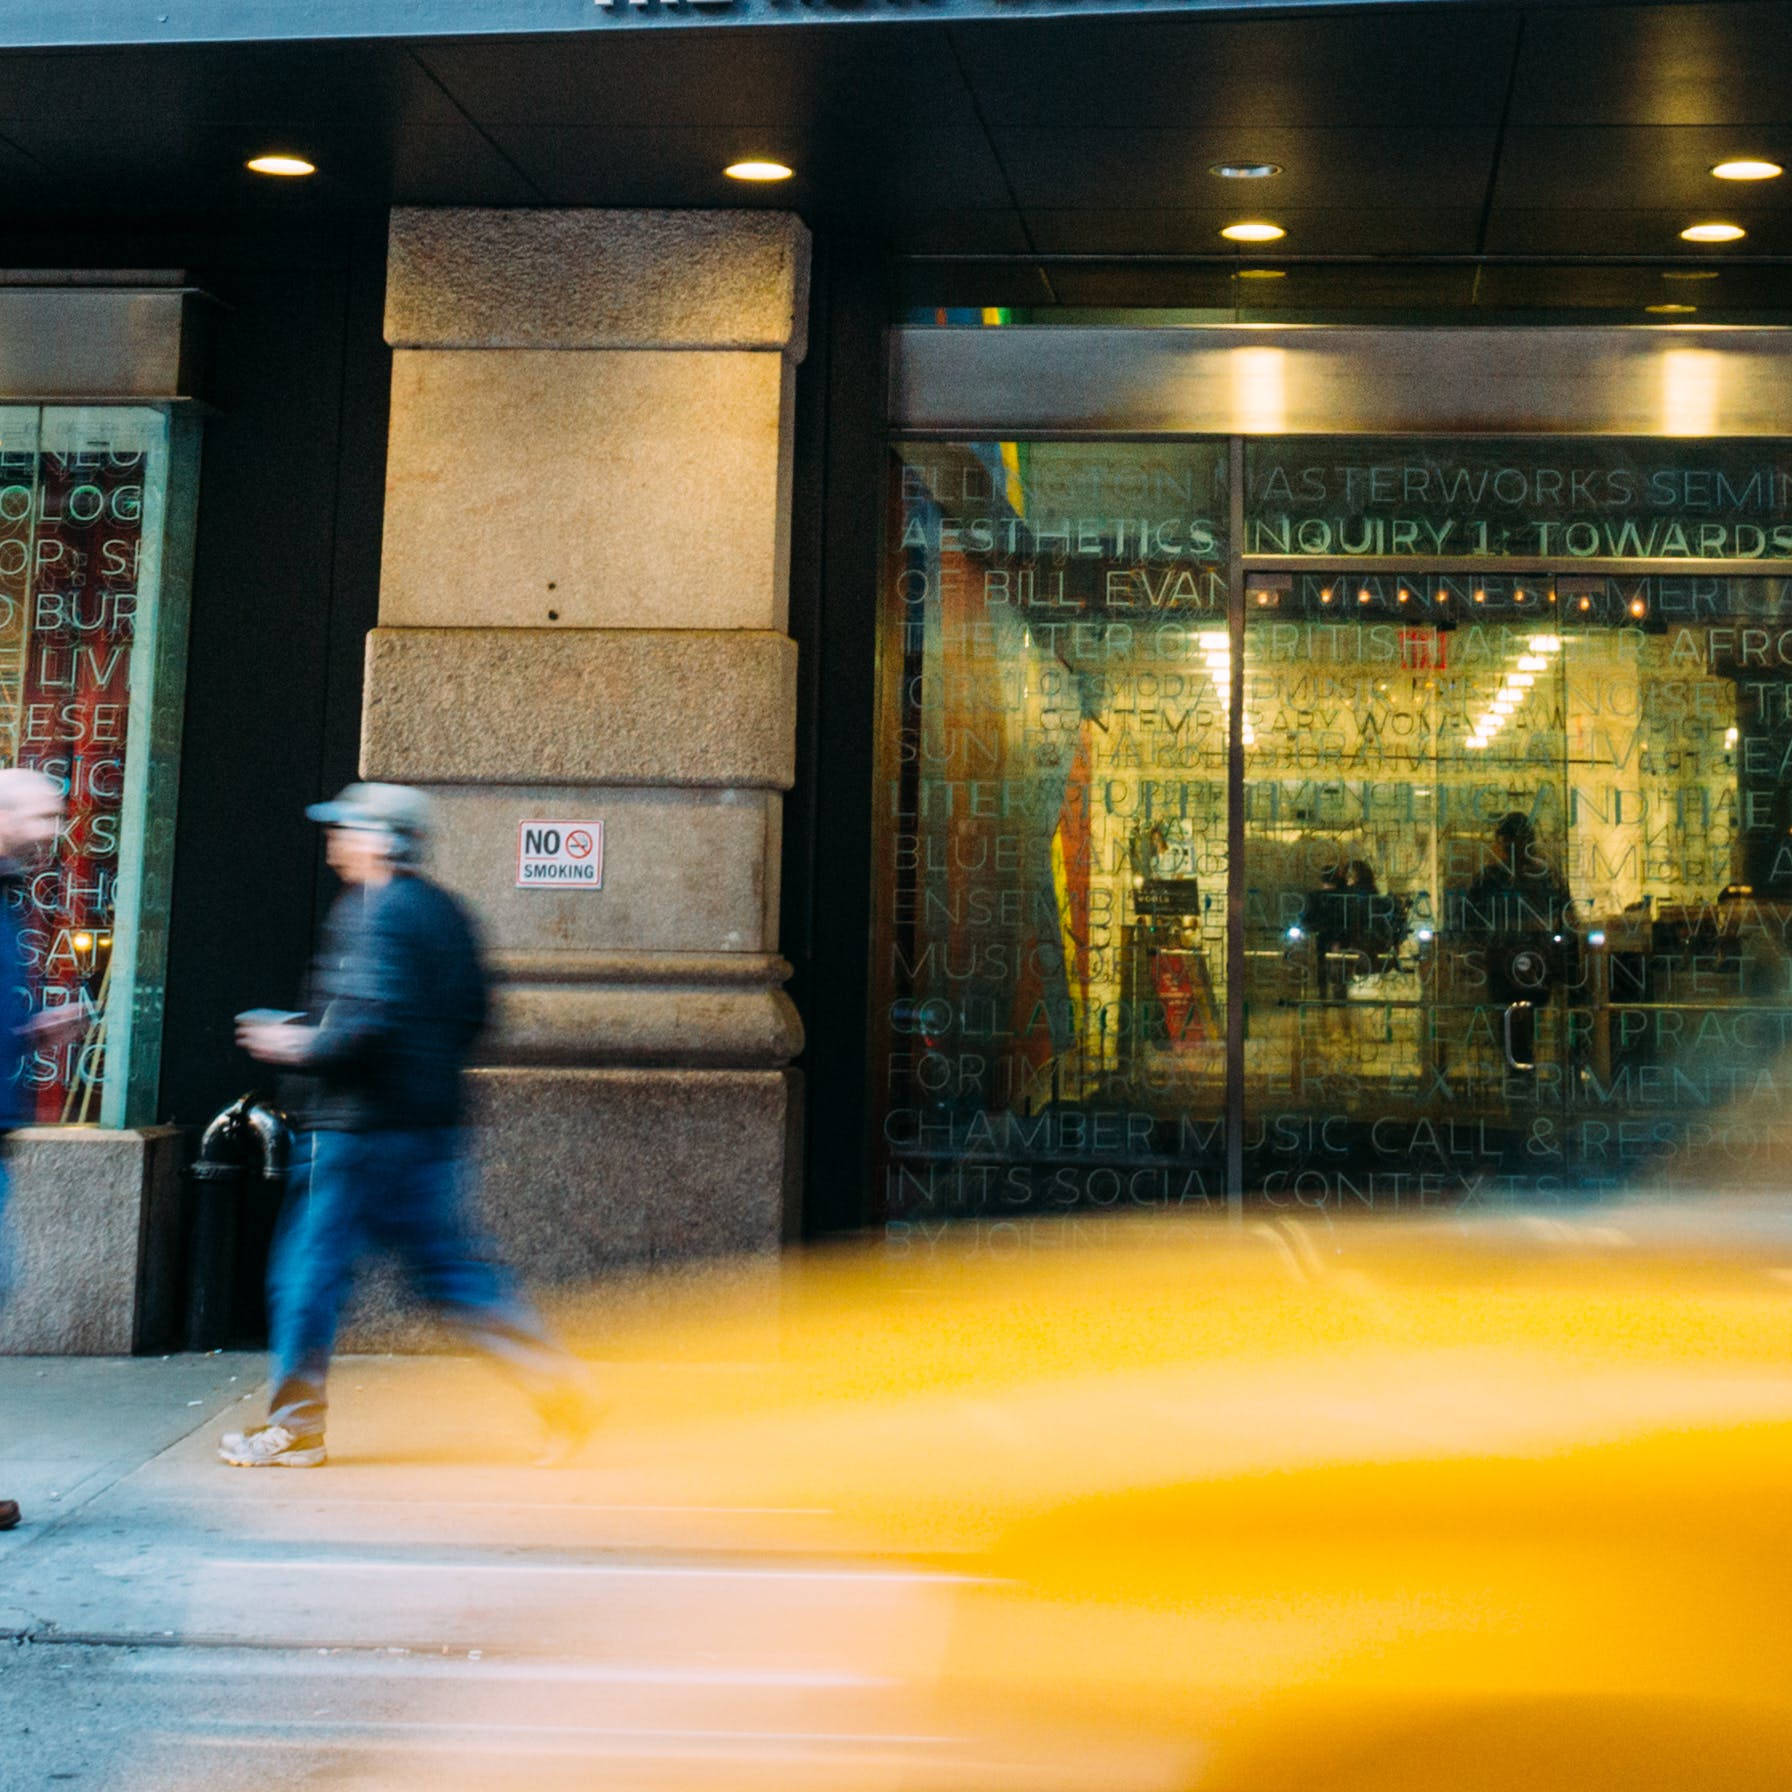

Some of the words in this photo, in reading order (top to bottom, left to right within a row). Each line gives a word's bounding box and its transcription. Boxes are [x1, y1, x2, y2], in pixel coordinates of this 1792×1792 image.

[900, 517, 1221, 560] AESTHETICS
[1243, 518, 1455, 556] INQUIRY
[895, 569, 965, 607] OF
[983, 570, 1081, 608] BILL
[525, 829, 560, 855] NO
[524, 864, 594, 879] SMOKING
[887, 1051, 987, 1092] FOR
[883, 1109, 1155, 1151] CHAMBER
[1370, 1116, 1505, 1158] CALL
[1525, 1117, 1563, 1157] &
